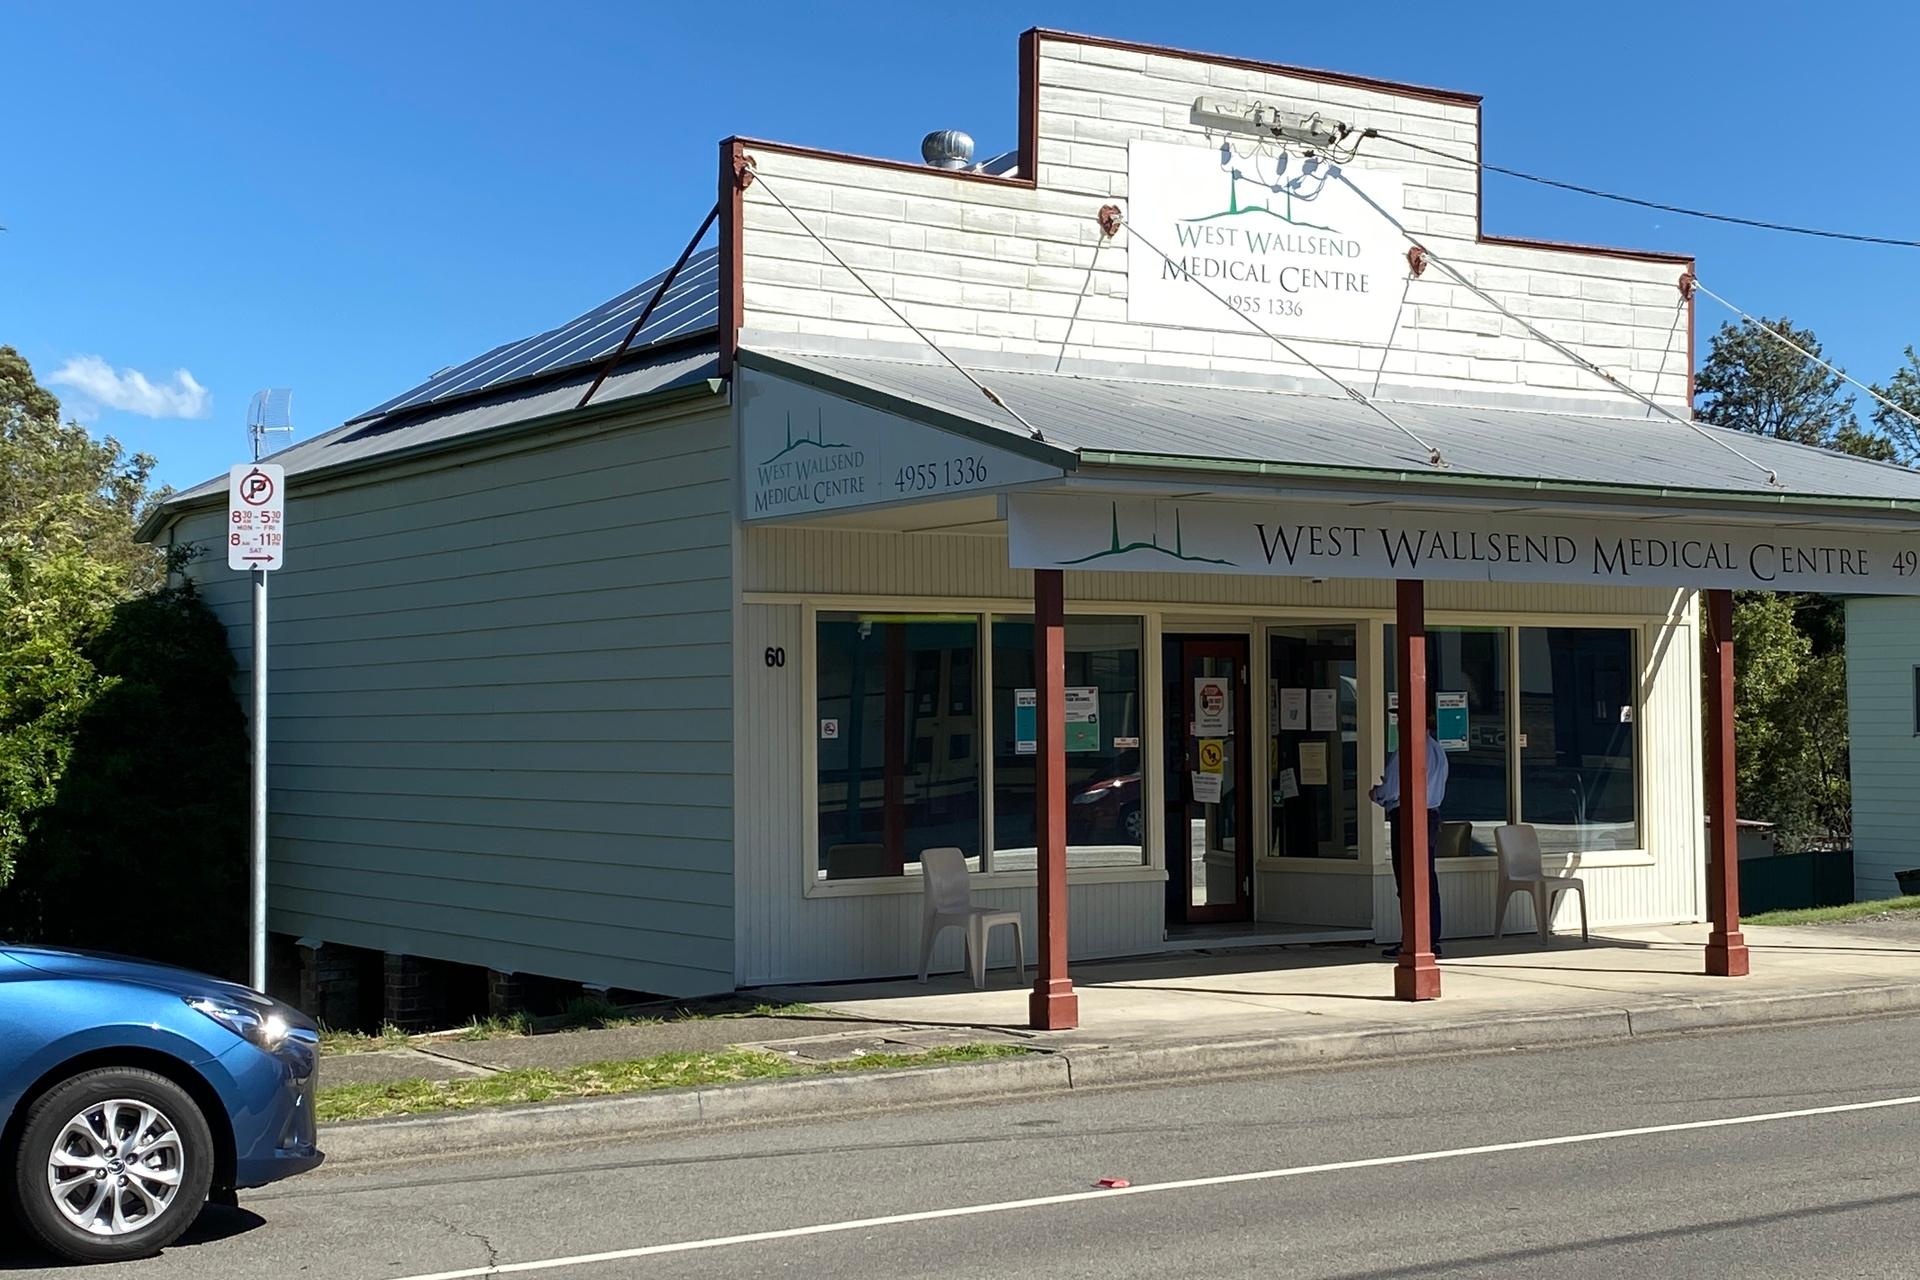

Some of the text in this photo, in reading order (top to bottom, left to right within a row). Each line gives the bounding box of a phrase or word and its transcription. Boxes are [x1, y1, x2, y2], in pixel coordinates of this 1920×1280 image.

[1175, 223, 1361, 258] WEST WALLSEND
[1161, 254, 1369, 293] MEDICAL CENTRE
[1225, 295, 1303, 317] 4955 1336
[758, 451, 864, 487] WEST WALLSEND
[894, 456, 988, 492] 4955 1336
[754, 476, 864, 513] MEDICAL CENTRE
[1254, 523, 1365, 565] WEST
[1377, 528, 1577, 569] WALLSEND
[1592, 536, 1738, 576] MEDICAL
[1750, 544, 1869, 581] CENTRE
[765, 647, 785, 667] 60
